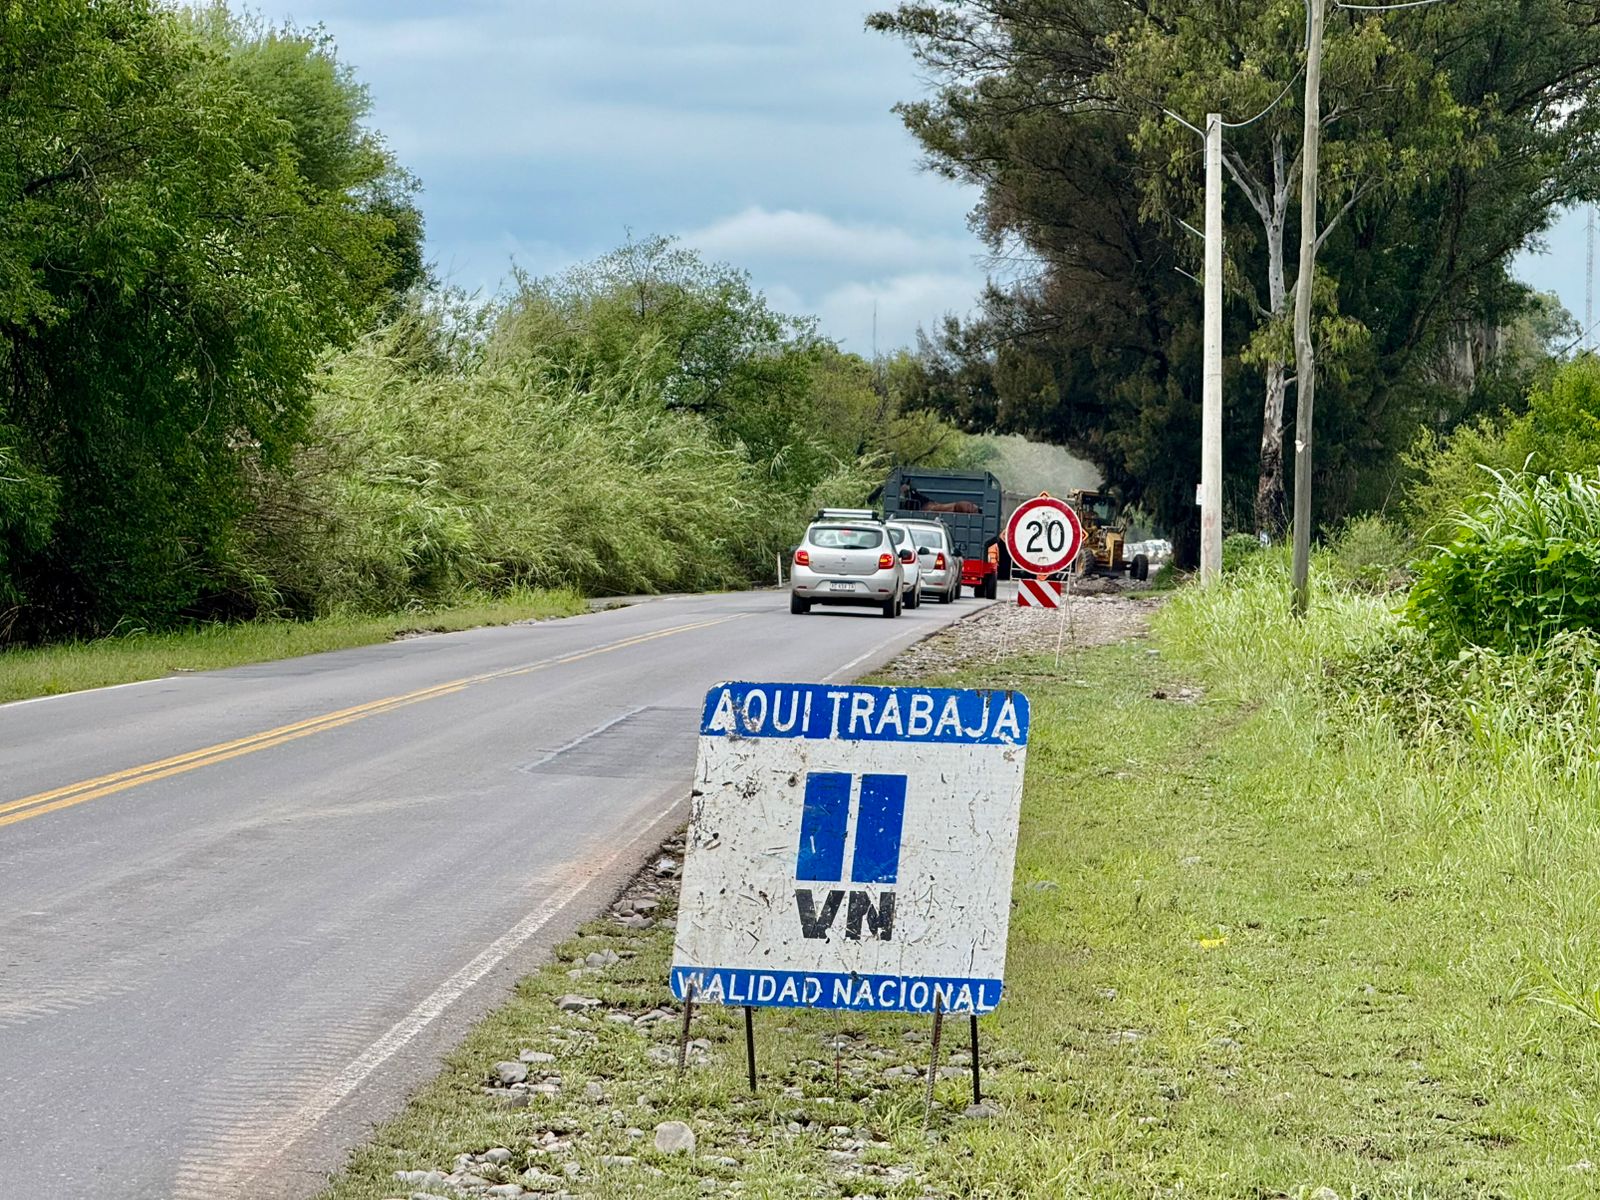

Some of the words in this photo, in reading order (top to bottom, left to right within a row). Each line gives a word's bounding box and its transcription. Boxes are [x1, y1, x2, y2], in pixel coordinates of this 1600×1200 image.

[1026, 520, 1065, 552] 20
[709, 688, 812, 732] AQUI
[827, 691, 1020, 739] TRABAJA
[795, 889, 896, 941] VN
[832, 978, 996, 1012] NACIONAL
